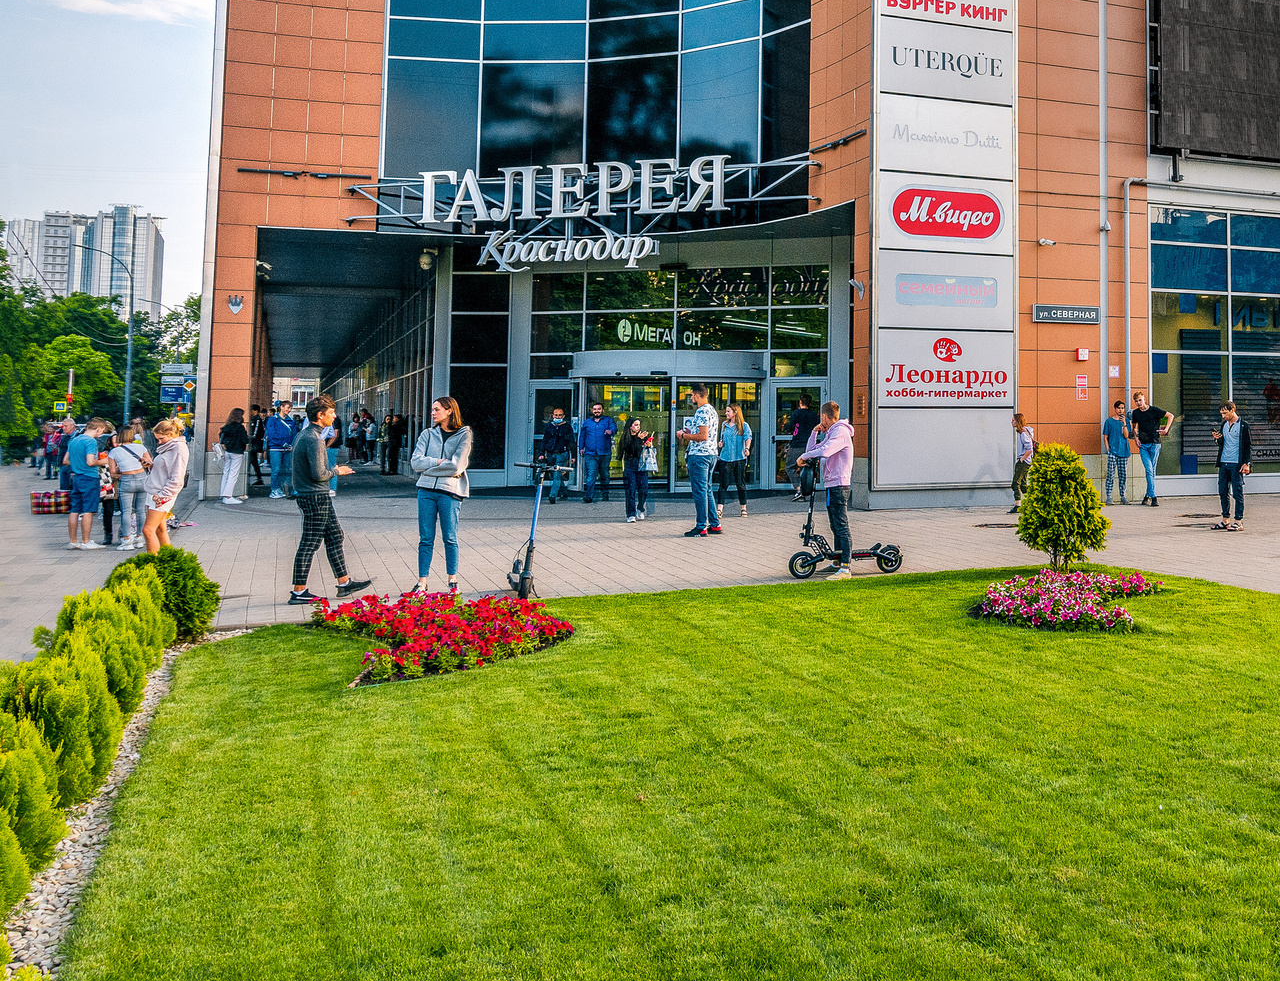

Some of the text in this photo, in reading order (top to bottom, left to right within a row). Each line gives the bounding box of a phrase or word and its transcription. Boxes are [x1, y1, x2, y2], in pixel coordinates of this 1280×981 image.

[960, 3, 1008, 23] КИНГ
[891, 45, 1003, 79] UTERQÜE
[893, 123, 1003, 150] Massimo Dutti
[417, 154, 731, 224] ГАЛЕРЕЯ
[476, 227, 655, 272] Краснодар
[1039, 310, 1096, 319] ул. СЕВЕРНАЯ
[885, 363, 1008, 389] Леонардо
[886, 388, 1008, 400] хобби-гипермаркет
